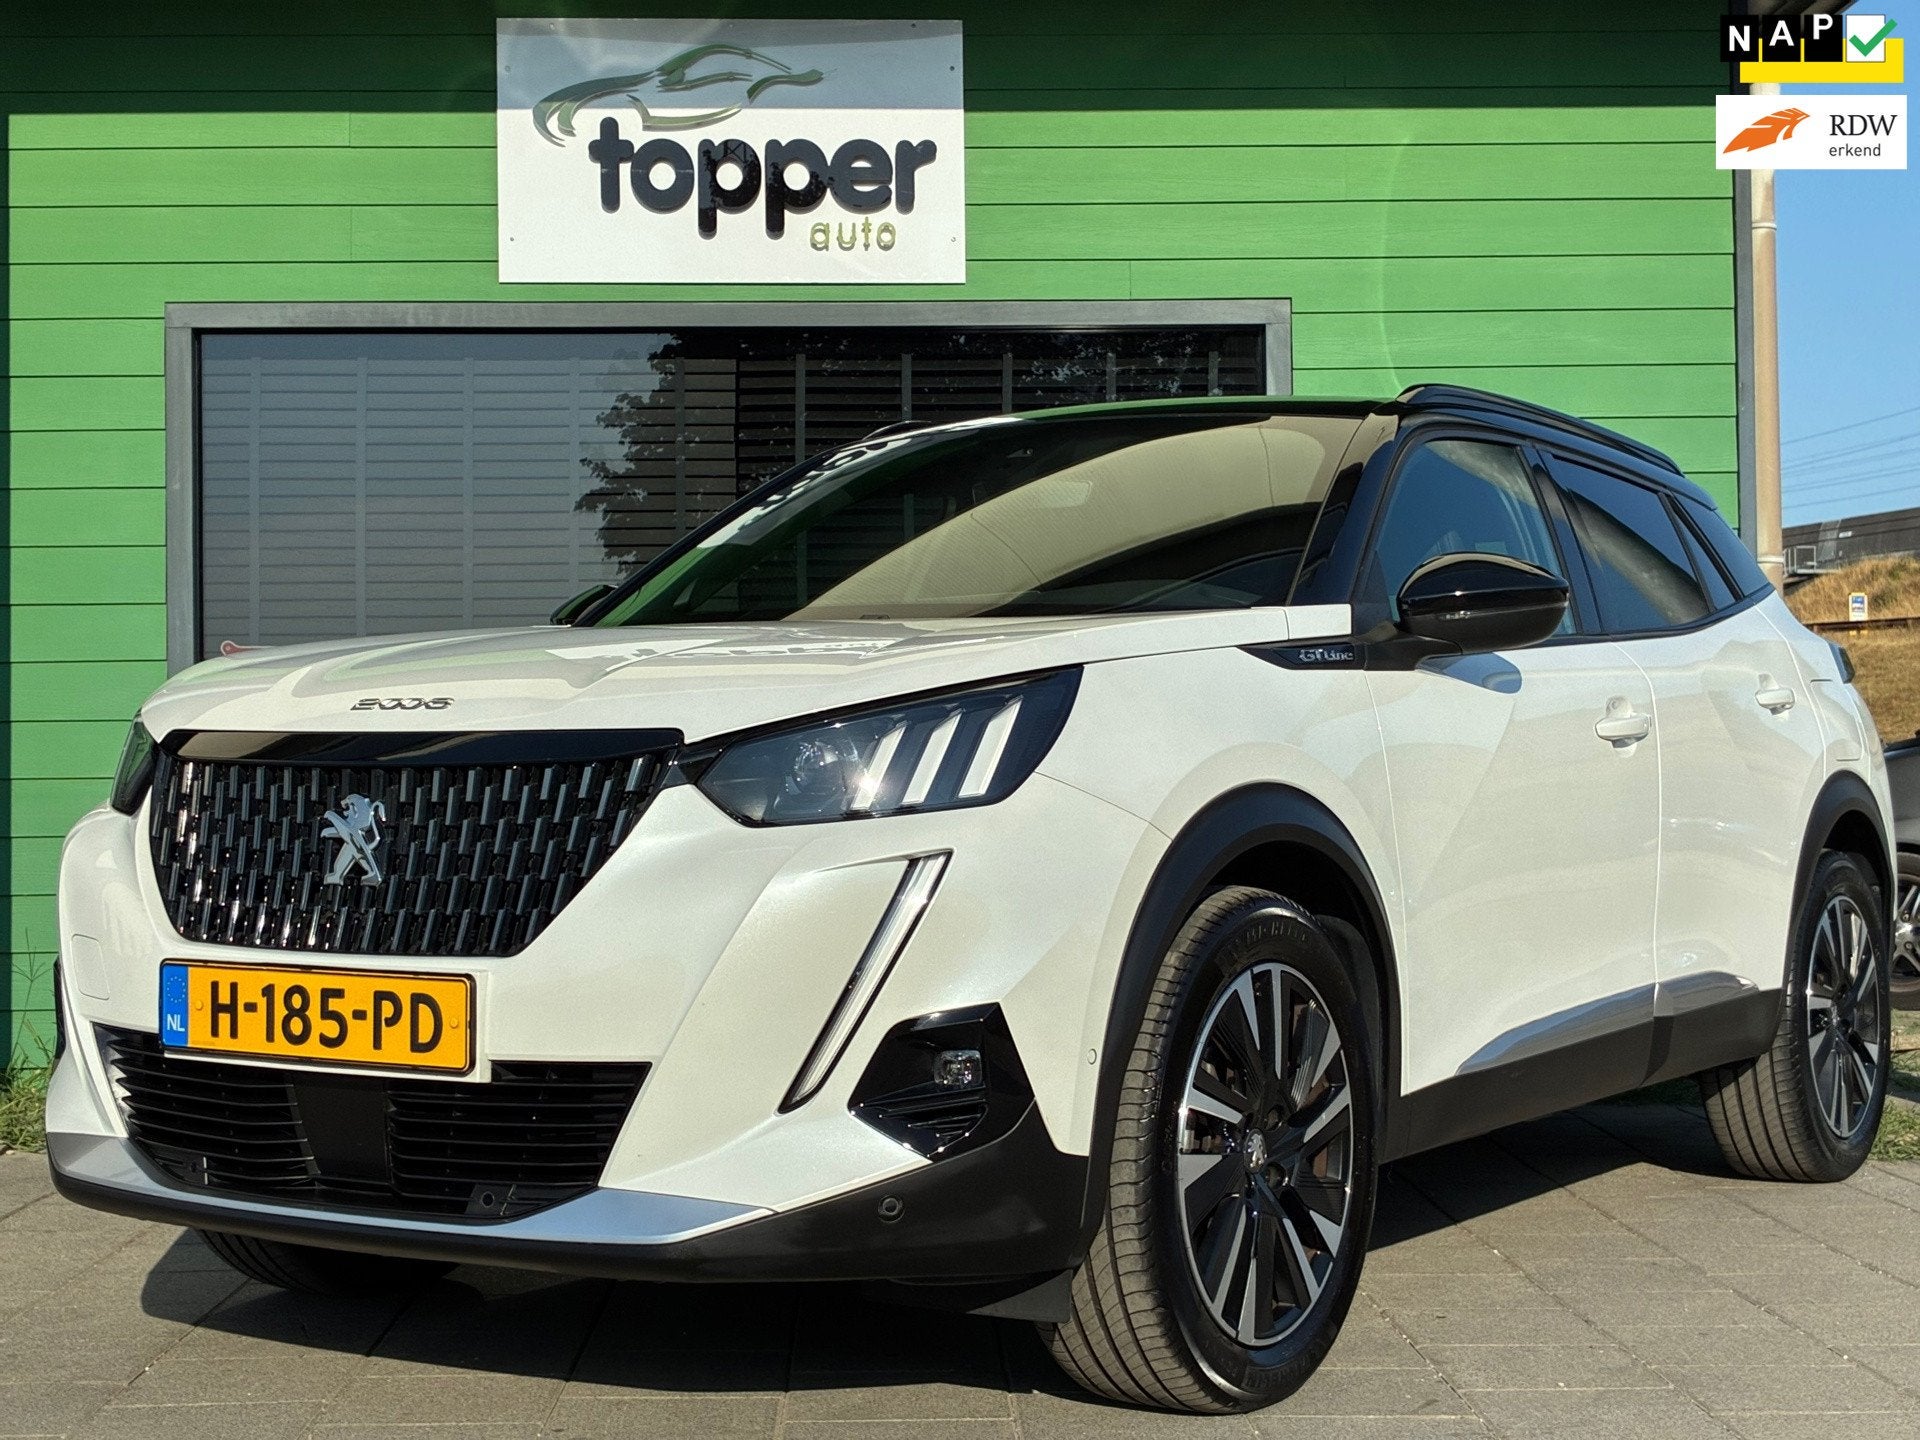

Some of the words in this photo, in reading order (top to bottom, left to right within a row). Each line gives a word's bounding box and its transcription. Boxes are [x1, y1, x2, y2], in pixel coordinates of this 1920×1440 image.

[588, 116, 937, 240] topper
[810, 217, 896, 251] auto
[350, 697, 455, 711] 2008
[167, 1013, 186, 1032] NL
[210, 980, 443, 1054] H-185-PD
